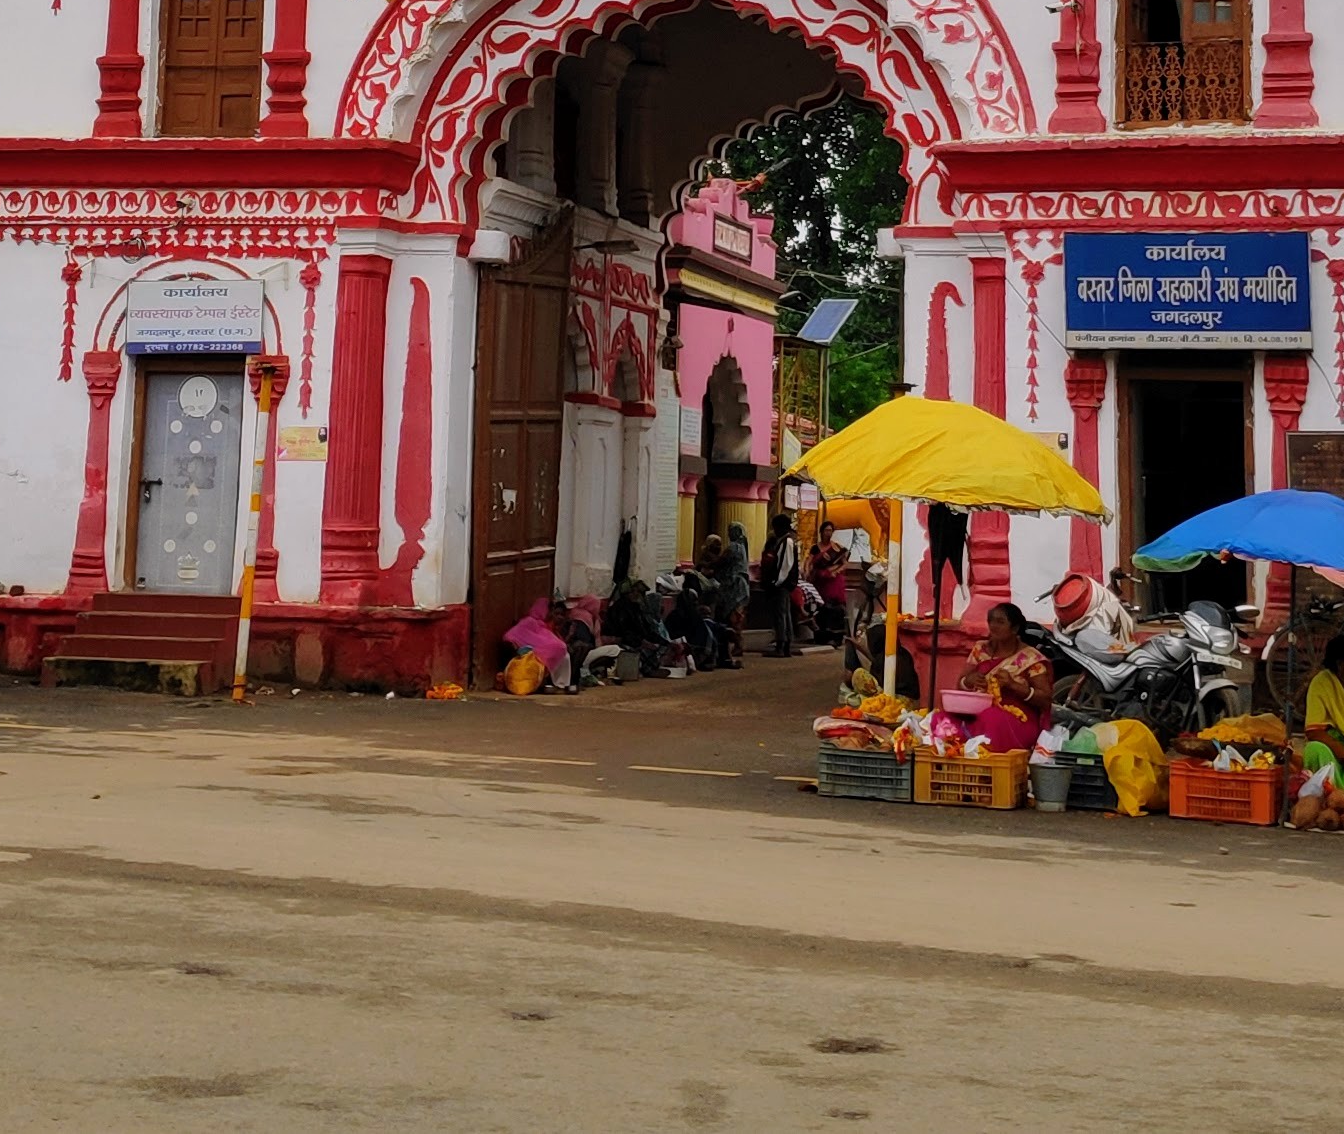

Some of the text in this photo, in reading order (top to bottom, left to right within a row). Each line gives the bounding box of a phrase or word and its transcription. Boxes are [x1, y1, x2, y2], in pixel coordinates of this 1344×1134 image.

[1145, 239, 1227, 261] कार्यालय
[163, 284, 228, 297] कार्यालय
[1076, 265, 1298, 306] बस्तर जिला सहकारी संघ मर्यादित
[129, 308, 193, 319] व्यवस्थापक
[193, 305, 226, 319] टेम्पल
[1150, 310, 1223, 330] जगदलपुर
